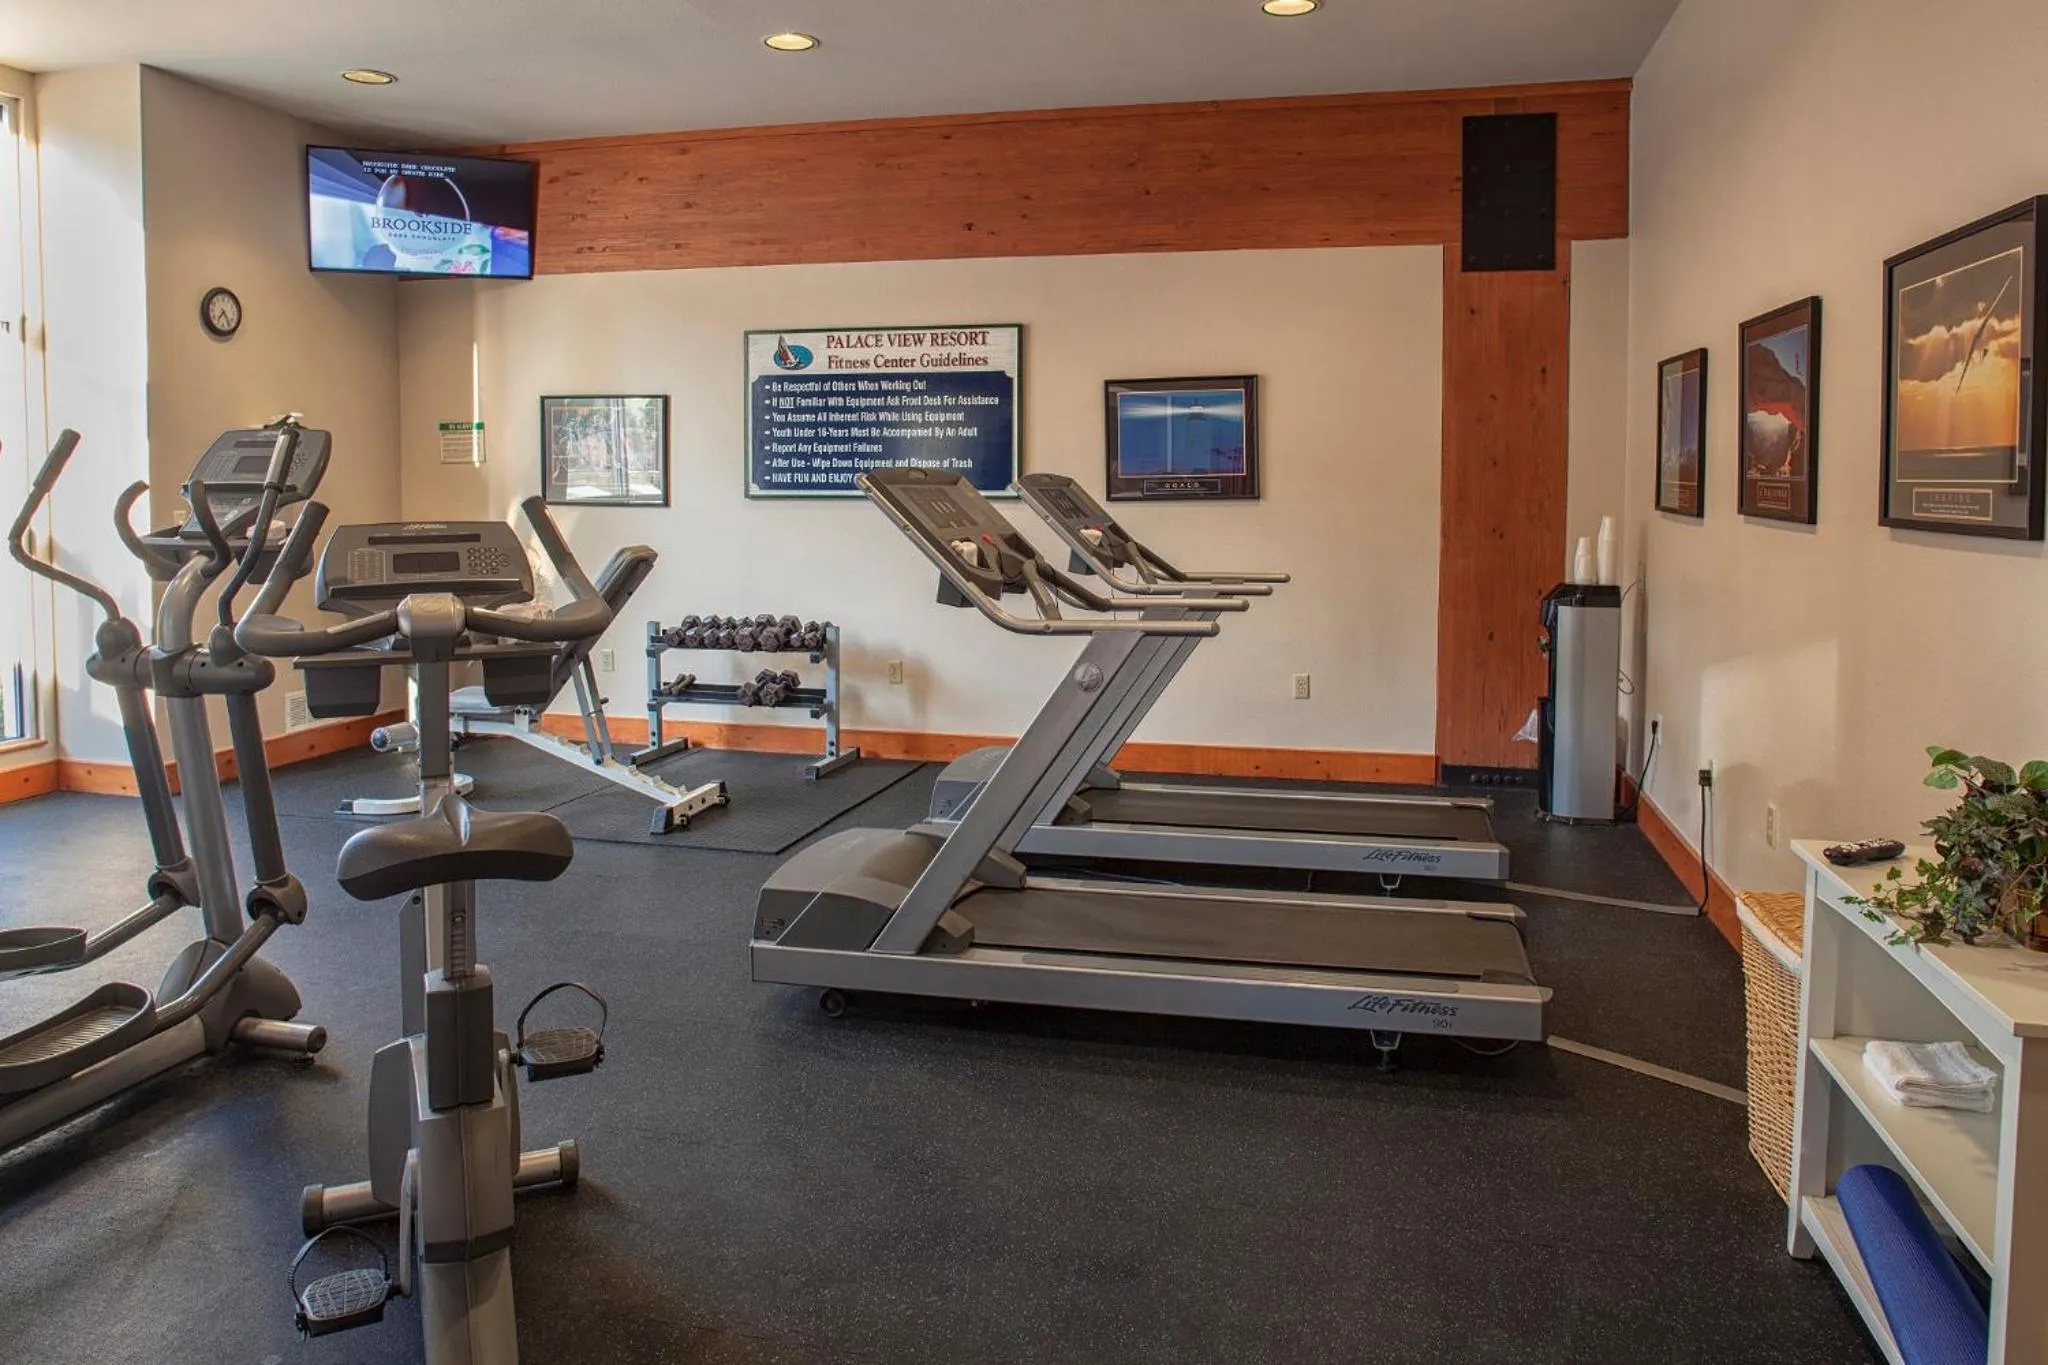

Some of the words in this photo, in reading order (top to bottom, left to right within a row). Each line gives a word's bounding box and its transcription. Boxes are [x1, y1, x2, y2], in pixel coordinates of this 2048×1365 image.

[371, 216, 473, 235] BROOKSIDE
[826, 334, 883, 349] PALACE
[887, 333, 927, 348] VIEW
[930, 331, 989, 346] RESORT
[828, 354, 870, 369] Fitness
[873, 354, 916, 368] Center
[919, 352, 989, 367] Guidelines
[783, 381, 821, 393] Respectful
[832, 381, 856, 391] Others
[858, 380, 878, 391] When
[880, 380, 911, 392] Working
[779, 397, 794, 407] NOT
[796, 397, 826, 407] Familiar
[827, 396, 845, 406] With
[846, 396, 885, 408] Equipment
[886, 395, 899, 406] Ask
[901, 395, 921, 406] Front
[943, 395, 956, 405] For
[957, 395, 999, 405] Assistance
[787, 412, 815, 422] Assume
[878, 411, 899, 421] While
[901, 411, 922, 422] Using
[924, 411, 964, 423] Equipment
[772, 427, 792, 437] Youth
[794, 427, 816, 437] Under
[850, 427, 870, 437] Must
[870, 427, 881, 437] Be
[882, 427, 932, 439] Accompanied
[934, 427, 943, 438] By
[945, 427, 956, 437] An
[958, 427, 978, 437] Adult
[772, 442, 797, 454] Report
[798, 442, 811, 454] Any
[813, 442, 852, 454] Equipment
[853, 442, 883, 453] Failures
[772, 458, 789, 468] After
[791, 458, 805, 468] Use
[812, 458, 831, 469] Wipe
[832, 458, 853, 468] Down
[854, 458, 893, 469] Equipment
[894, 457, 909, 468] and
[910, 457, 941, 468] Dispose
[951, 457, 973, 468] Trash
[772, 473, 792, 483] HAVE
[794, 473, 810, 483] FUN
[811, 473, 827, 483] AND
[829, 472, 853, 483] ENJOY
